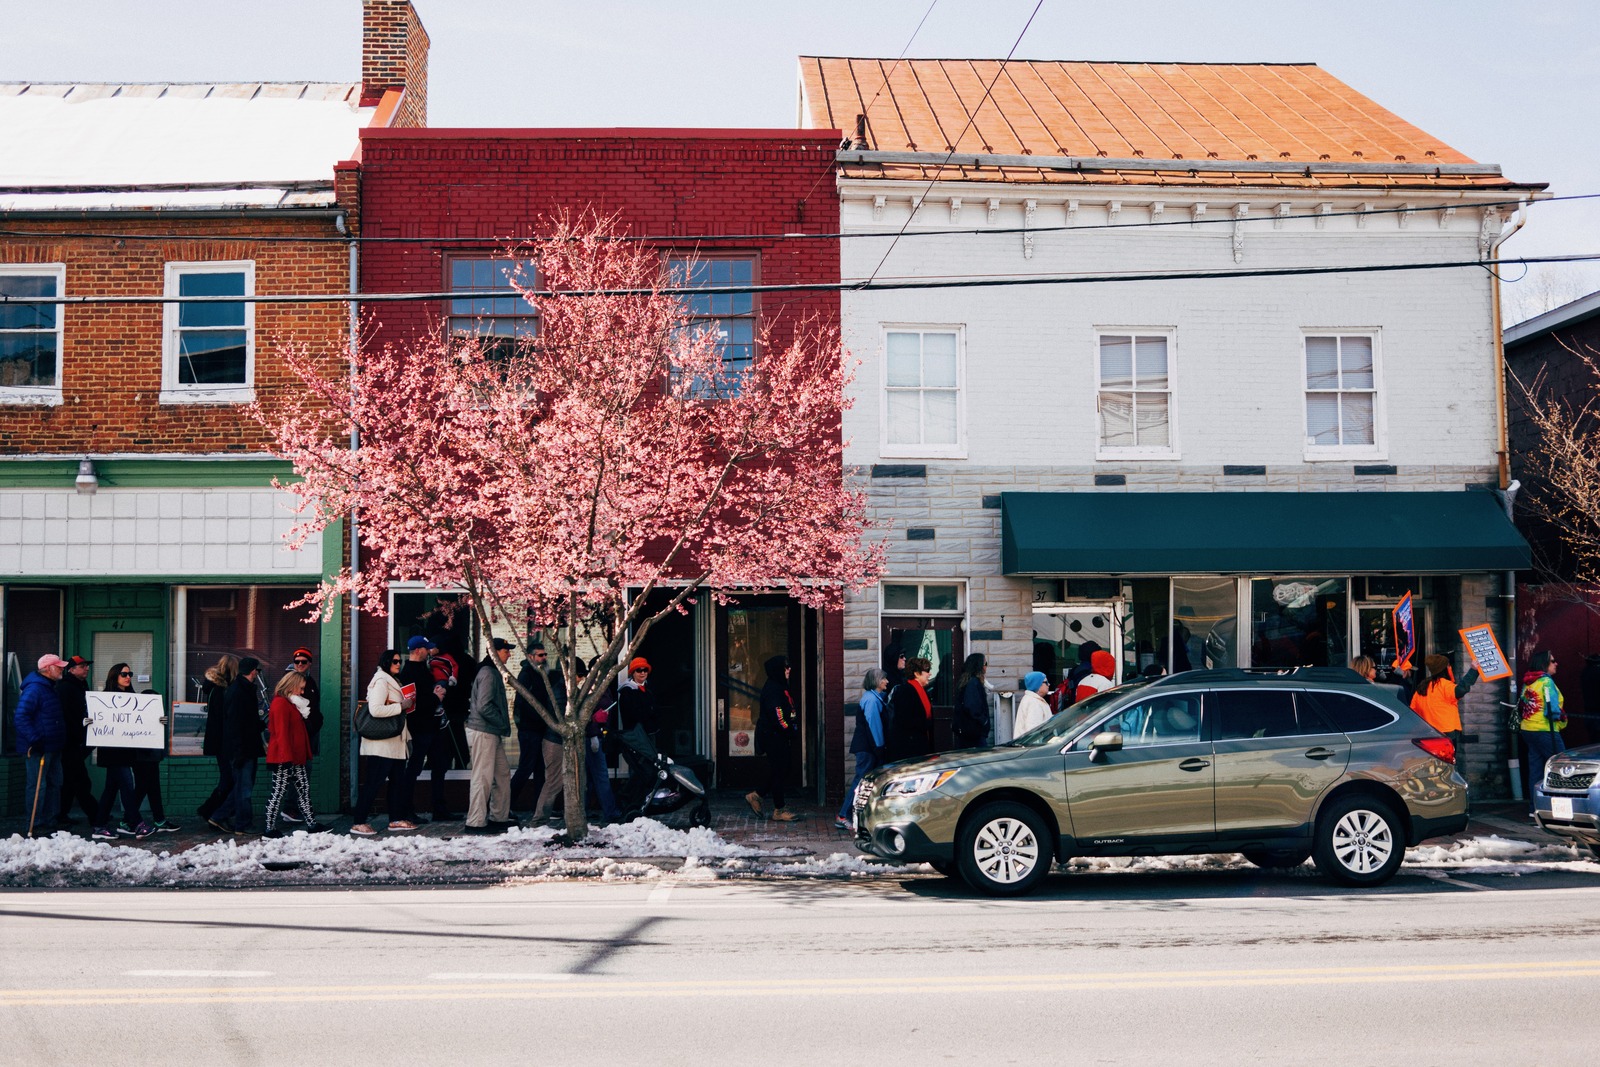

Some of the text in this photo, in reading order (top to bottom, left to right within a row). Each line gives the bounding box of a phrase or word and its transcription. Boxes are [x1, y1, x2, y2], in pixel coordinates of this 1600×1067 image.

[1035, 590, 1047, 601] 37
[112, 620, 125, 630] 41
[94, 711, 143, 724] IS NOT A
